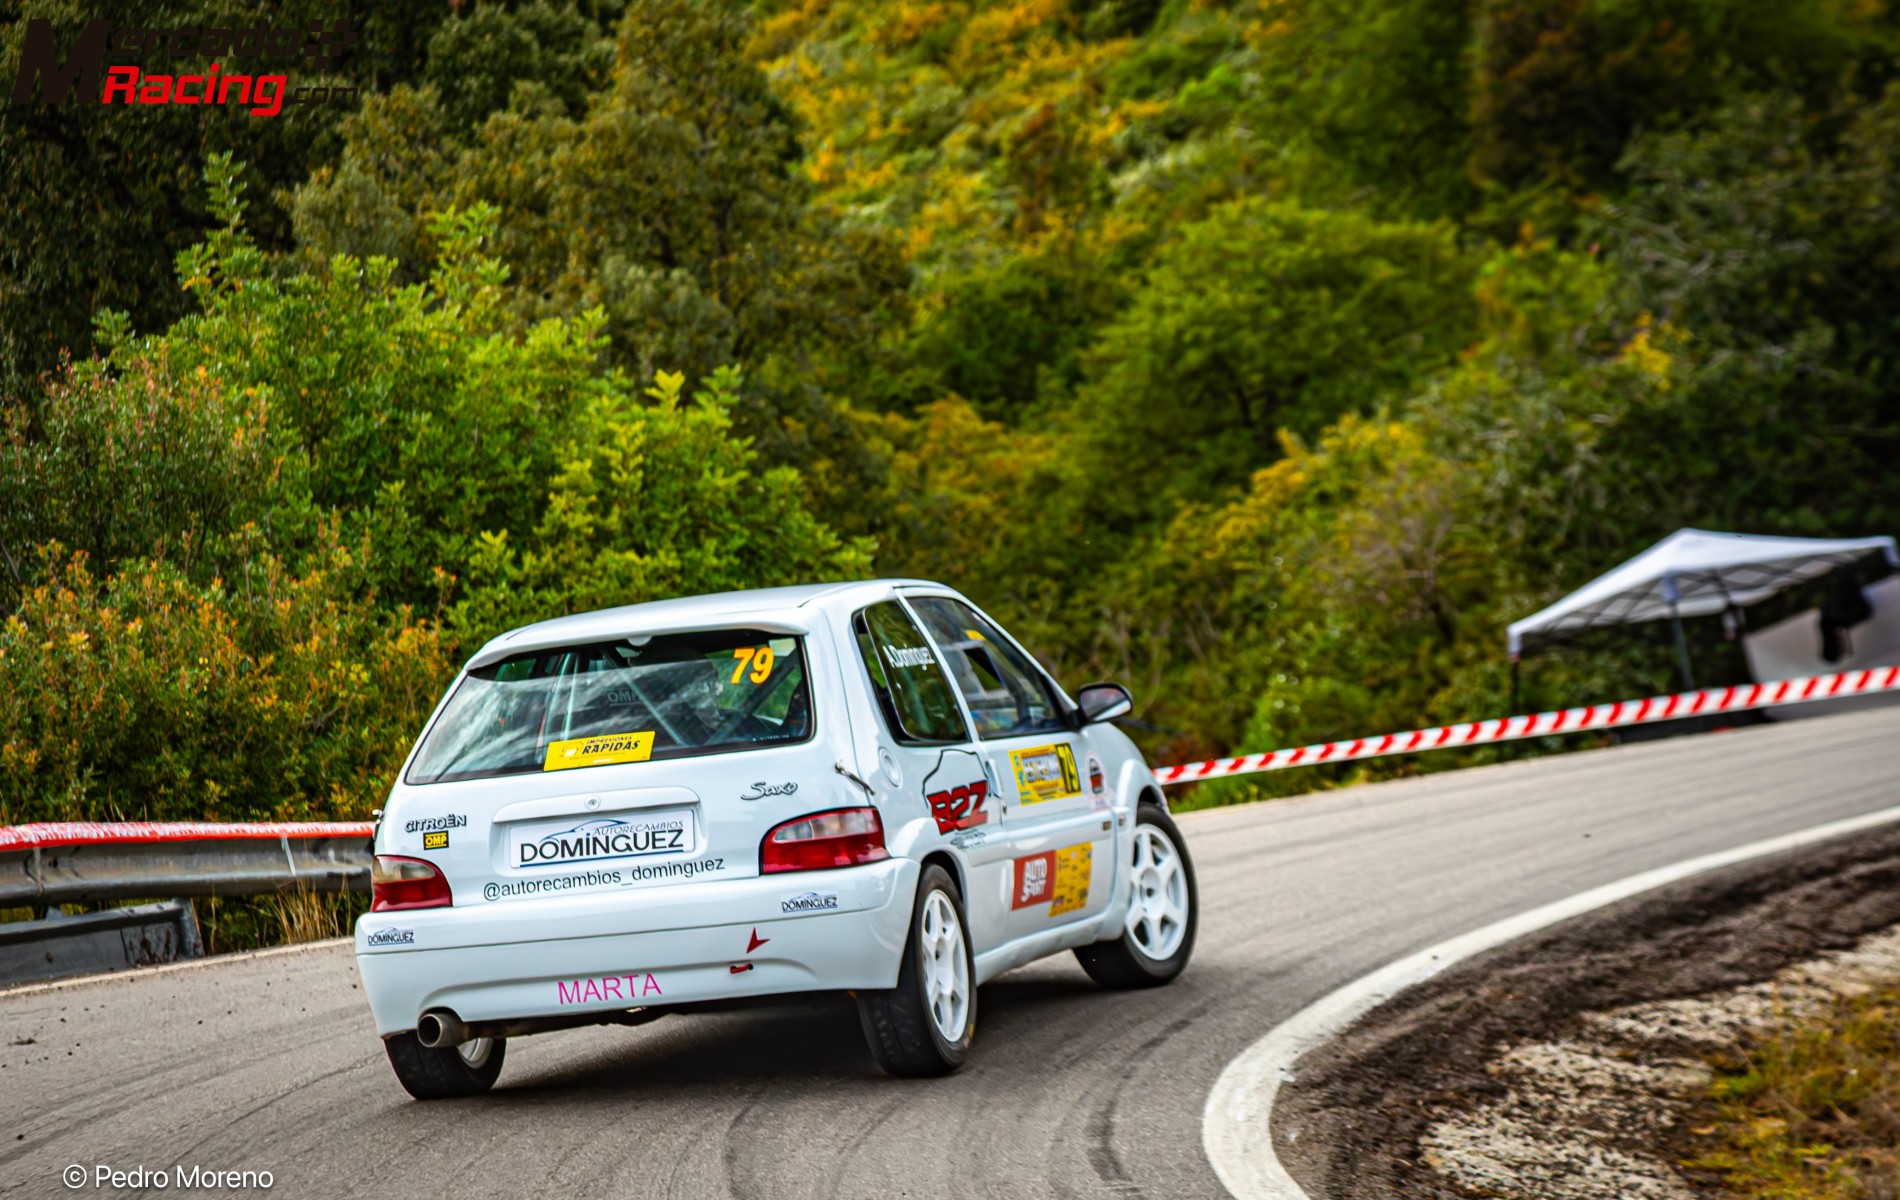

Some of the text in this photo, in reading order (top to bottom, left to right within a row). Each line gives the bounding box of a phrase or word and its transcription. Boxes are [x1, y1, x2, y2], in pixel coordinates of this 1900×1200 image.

[731, 647, 774, 684] 79
[1056, 744, 1080, 793] 79
[740, 781, 798, 801] Saxo
[405, 813, 467, 833] CITROËN
[593, 820, 684, 836] AUTORECAMBIOS
[425, 834, 447, 847] OMP
[483, 857, 725, 902] @autorecambios_dominguez
[557, 972, 662, 1005] MARTA
